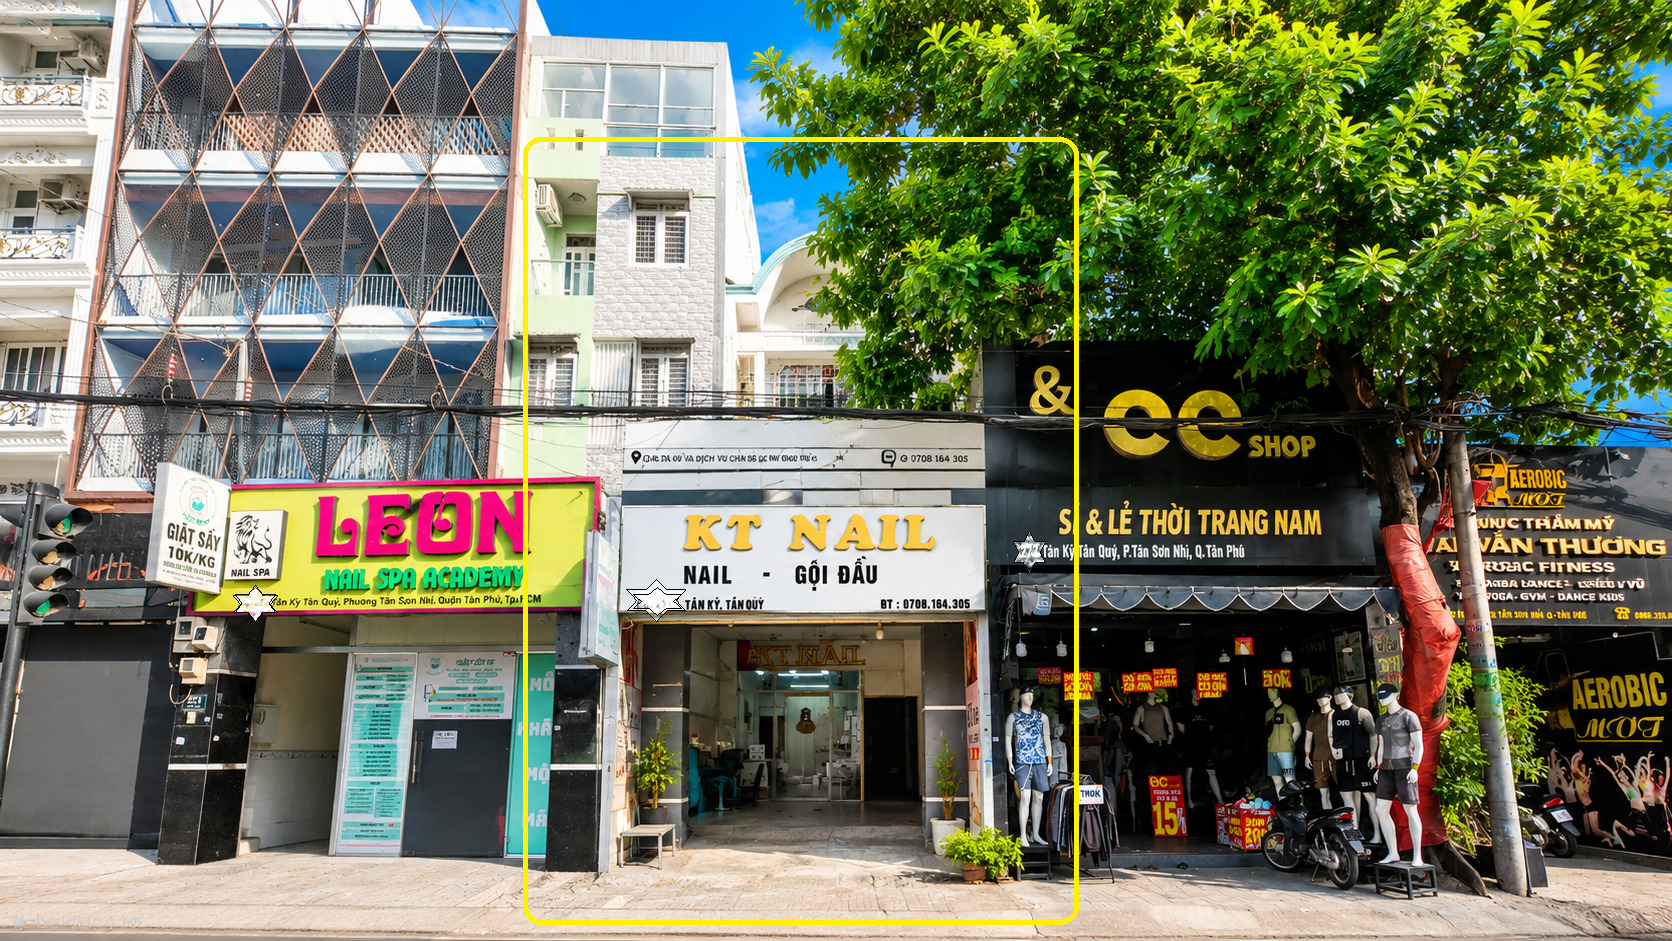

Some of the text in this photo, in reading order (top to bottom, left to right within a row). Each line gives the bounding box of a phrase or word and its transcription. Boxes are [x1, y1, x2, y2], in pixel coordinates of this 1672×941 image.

[1248, 435, 1316, 459] SHOP
[1510, 469, 1568, 489] AEROBIC
[315, 491, 533, 557] LEON
[1085, 508, 1103, 535] &
[1138, 502, 1190, 535] THỜI
[1198, 509, 1269, 535] TRANG
[1274, 509, 1322, 535] NAM
[682, 514, 936, 551] KT NAIL
[1152, 544, 1170, 558] Sơn
[230, 568, 270, 577] NAIL SPA
[324, 565, 524, 591] NAIL SPA ACADEMY
[683, 565, 732, 585] NAIL
[795, 559, 828, 591] GỘI
[1557, 592, 1596, 601] DANCE
[1573, 672, 1667, 710] AEROBIC
